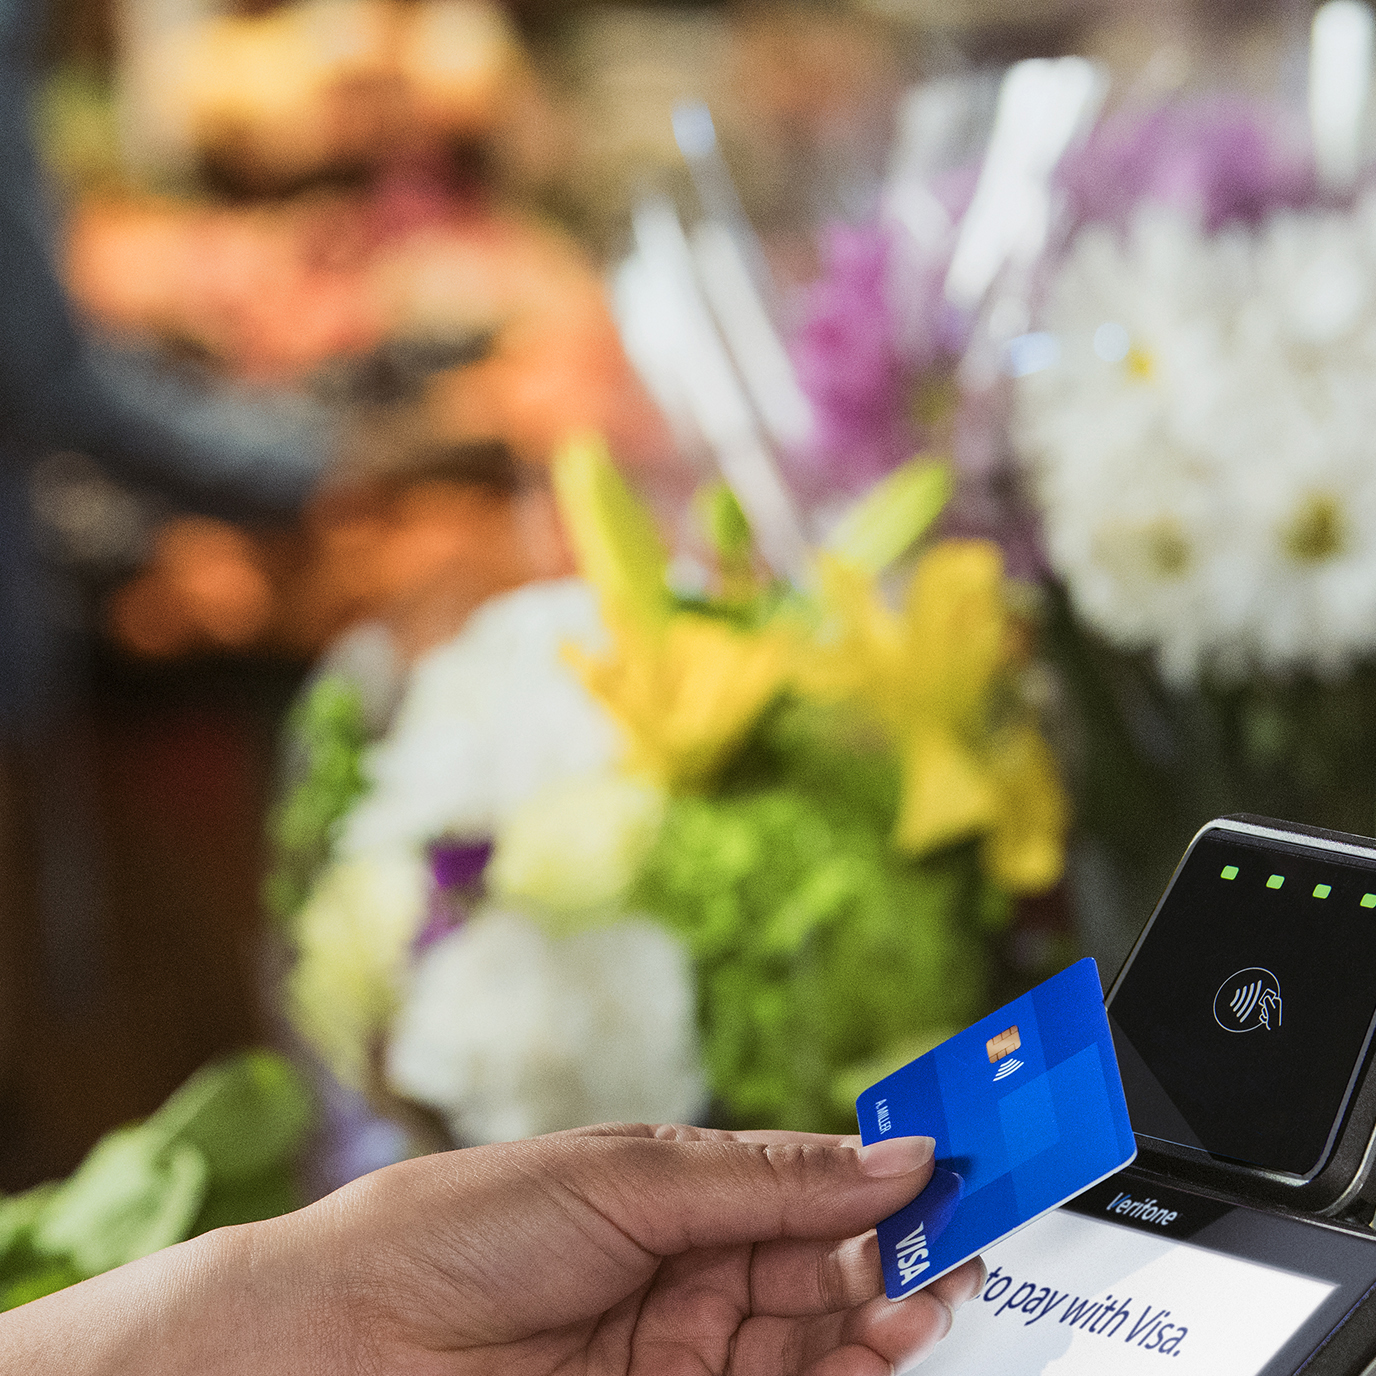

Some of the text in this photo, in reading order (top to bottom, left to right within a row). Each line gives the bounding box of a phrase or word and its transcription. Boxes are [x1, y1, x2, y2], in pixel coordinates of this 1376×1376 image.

[876, 1105, 892, 1135] MILLER
[1105, 1191, 1179, 1226] Verifone
[895, 1221, 931, 1287] VISA
[983, 1266, 1189, 1358] to pay with Visa.
